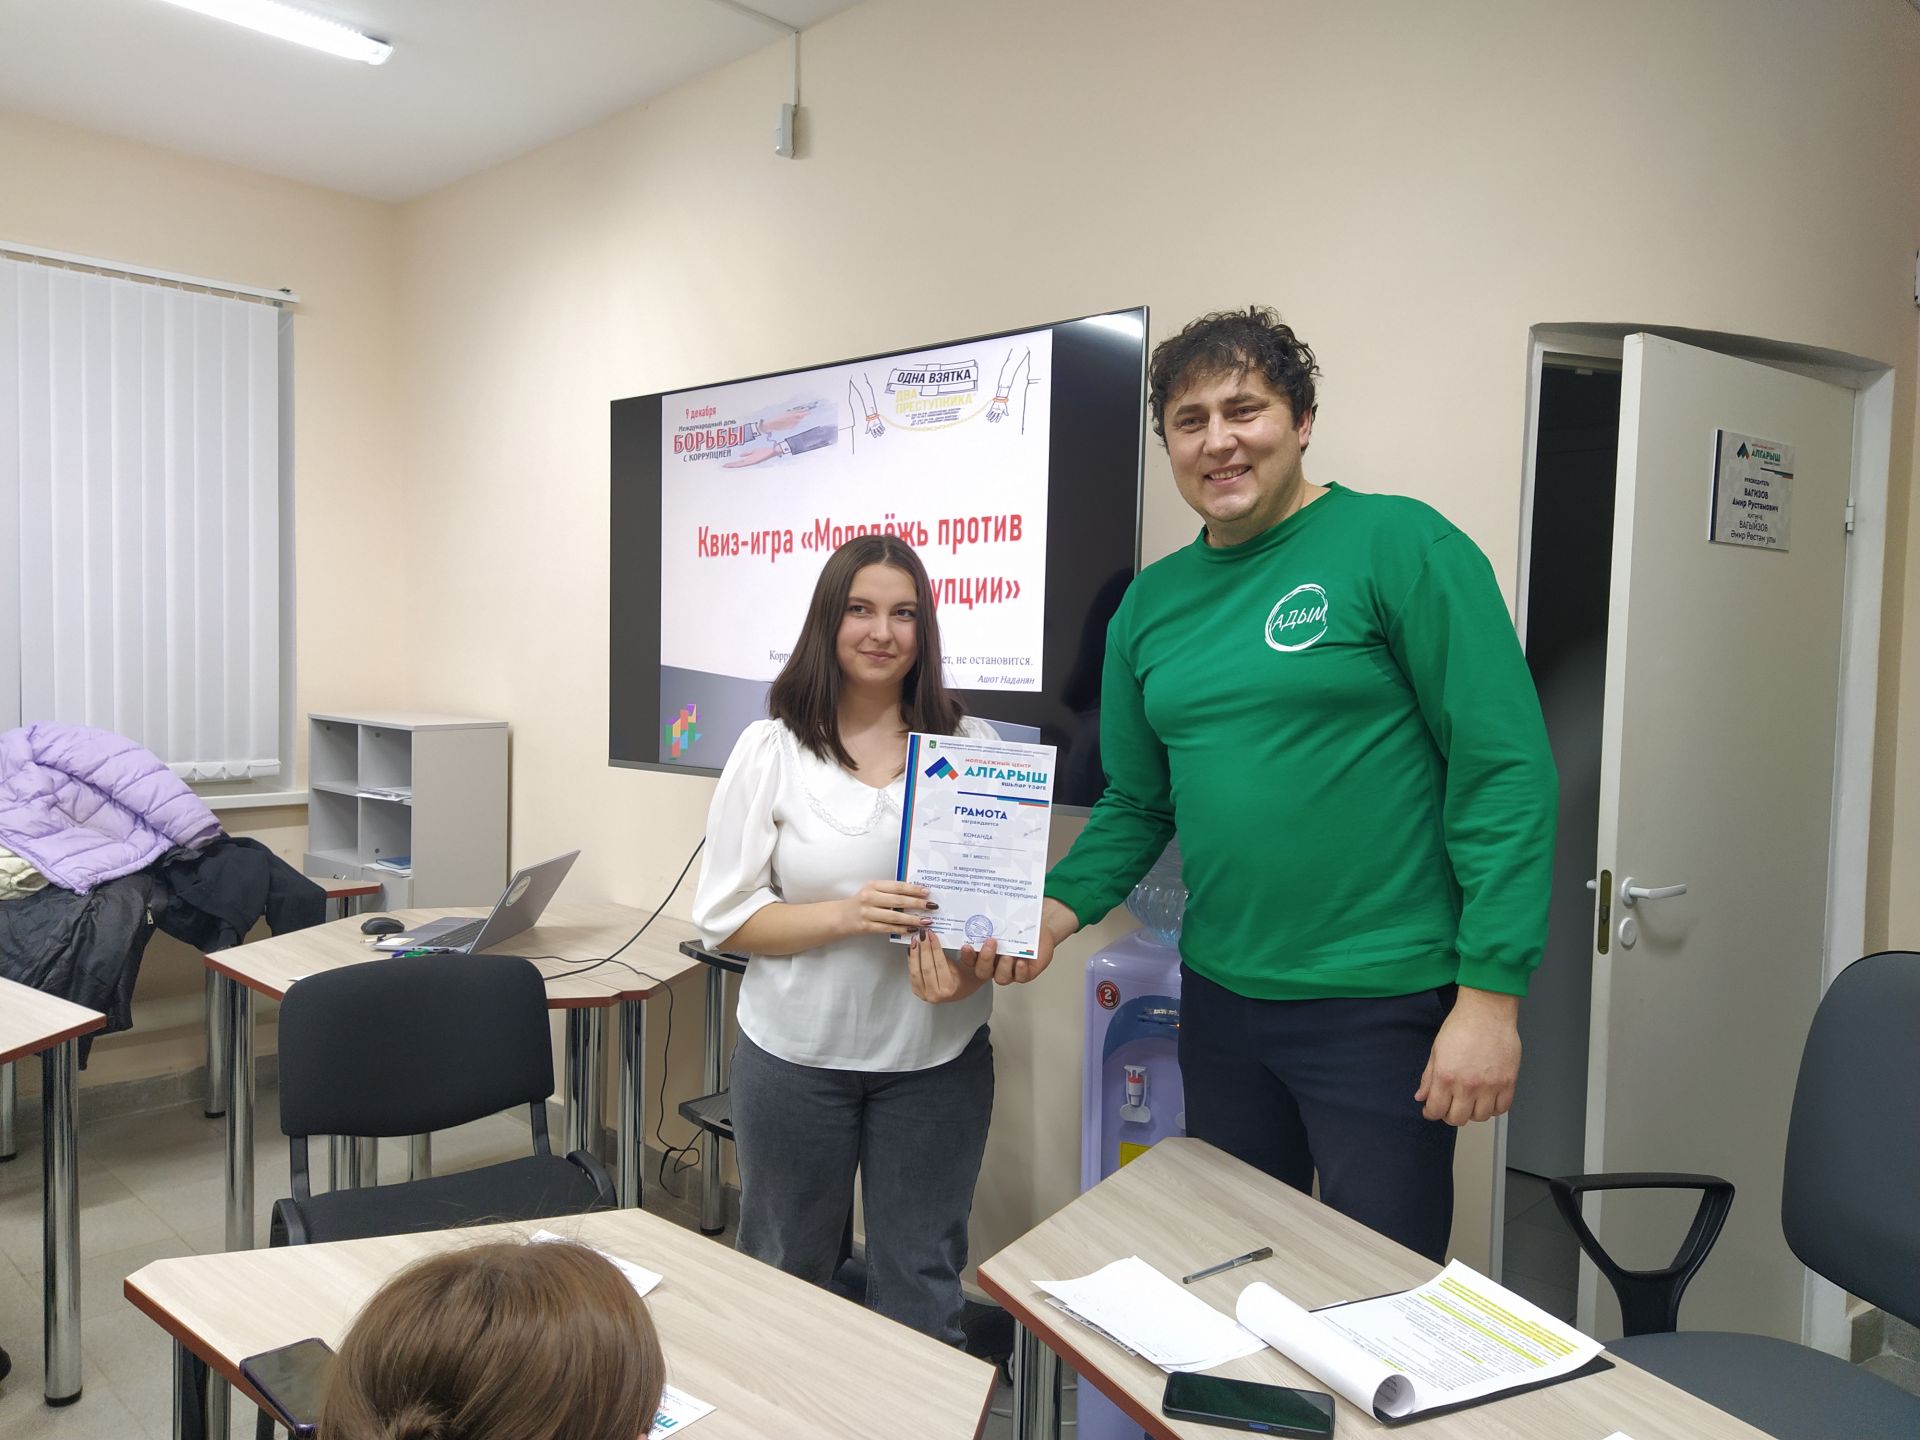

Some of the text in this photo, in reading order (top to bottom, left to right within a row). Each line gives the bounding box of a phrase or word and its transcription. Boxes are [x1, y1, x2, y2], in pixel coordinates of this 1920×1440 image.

[897, 369, 971, 384] ОДНА ВЗЯТКА
[896, 388, 918, 402] ДВА
[896, 393, 974, 414] ПРЕСТУПНИКА
[690, 405, 717, 420] декабря
[678, 420, 722, 432] Международный
[673, 425, 745, 454] БОРЬБЫ
[689, 449, 732, 462] КОРРУПЦИЕЙ
[1751, 449, 1781, 462] АЛГАРЫШ
[1744, 487, 1769, 500] ВАГИЗОВ
[1732, 497, 1778, 512] Амир Рустамович
[698, 526, 794, 563] Квиз-игра
[937, 514, 1023, 554] против
[930, 577, 1021, 610] упции»
[1271, 606, 1326, 632] АДЫМ
[956, 656, 967, 665] не
[969, 656, 1034, 666] остановится.
[977, 674, 1035, 685] Ашот Наданян
[965, 757, 1011, 768] МОЛОДЕЖНЫЙ
[964, 766, 1048, 784] АЛГАРЫШ
[954, 806, 1008, 820] ГРАМОТА
[963, 832, 993, 840] КОМАНДА
[1104, 988, 1112, 1000] 2
